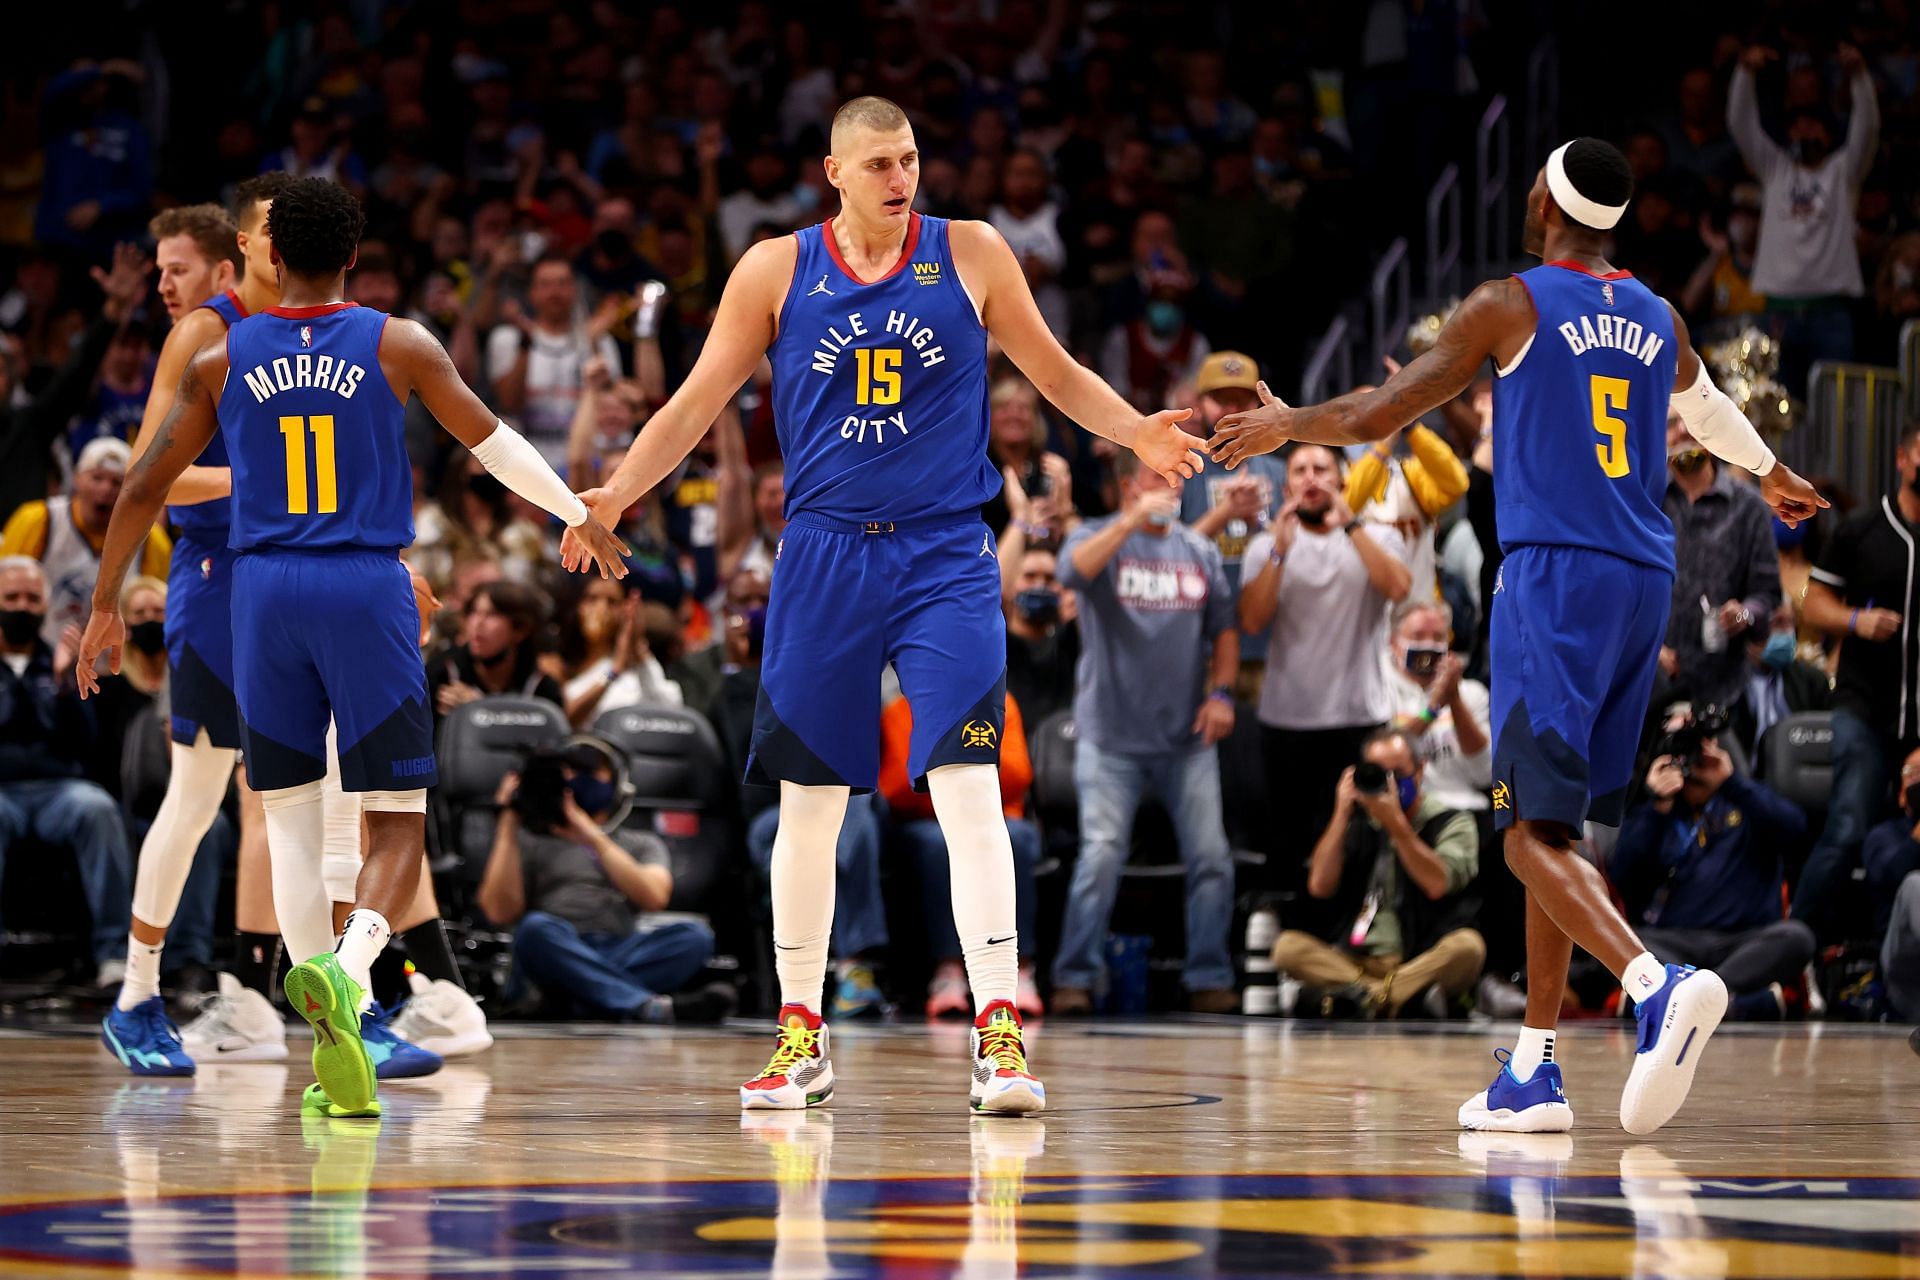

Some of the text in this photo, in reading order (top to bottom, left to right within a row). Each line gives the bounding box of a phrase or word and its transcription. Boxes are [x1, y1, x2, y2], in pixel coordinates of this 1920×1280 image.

[912, 262, 940, 275] WU
[811, 309, 946, 375] MILE HIGH
[1557, 314, 1664, 367] BARTON
[243, 354, 366, 404] MORRIS
[854, 348, 903, 406] 15
[840, 411, 909, 444] CITY
[1590, 374, 1631, 479] 5
[279, 414, 337, 514] 11
